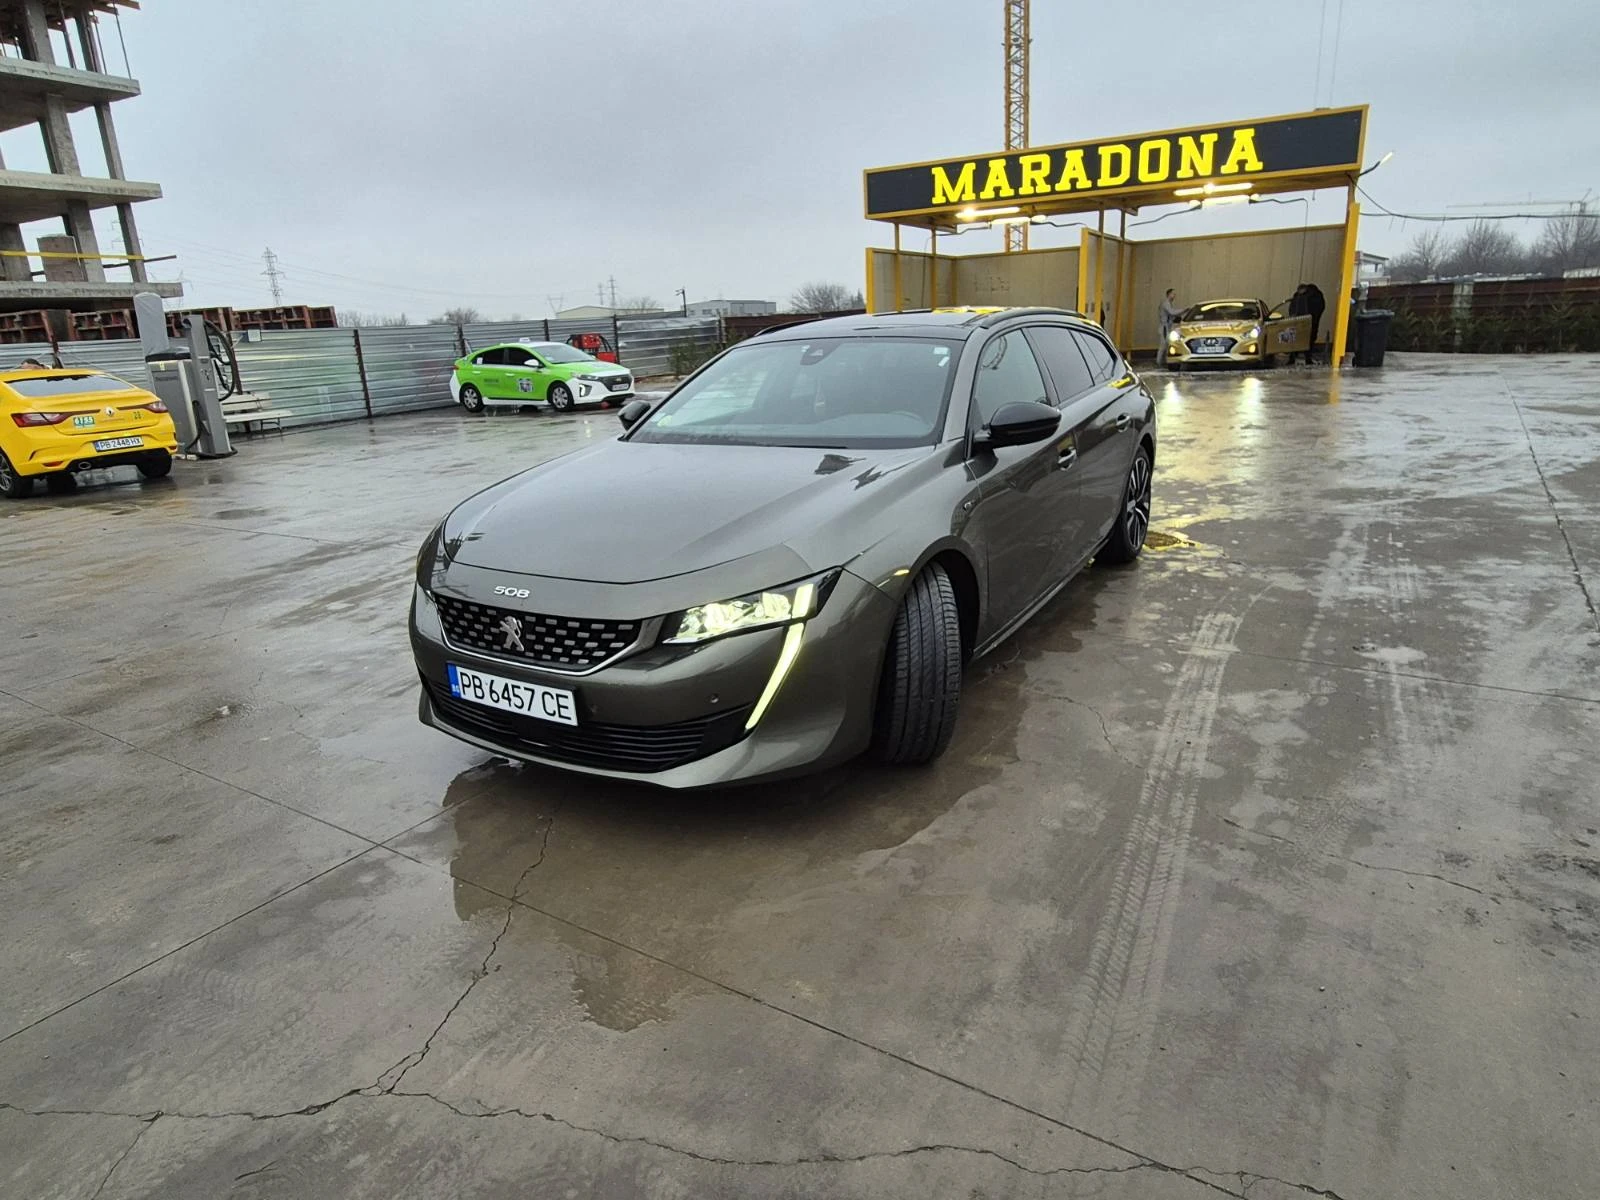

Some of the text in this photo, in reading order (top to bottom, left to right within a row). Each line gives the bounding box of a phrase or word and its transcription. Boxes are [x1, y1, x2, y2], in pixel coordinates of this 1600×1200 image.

[931, 128, 1263, 204] MARADONA
[494, 585, 530, 598] 508
[460, 672, 485, 699] PB
[489, 679, 535, 712] 6457
[541, 691, 572, 721] CE
